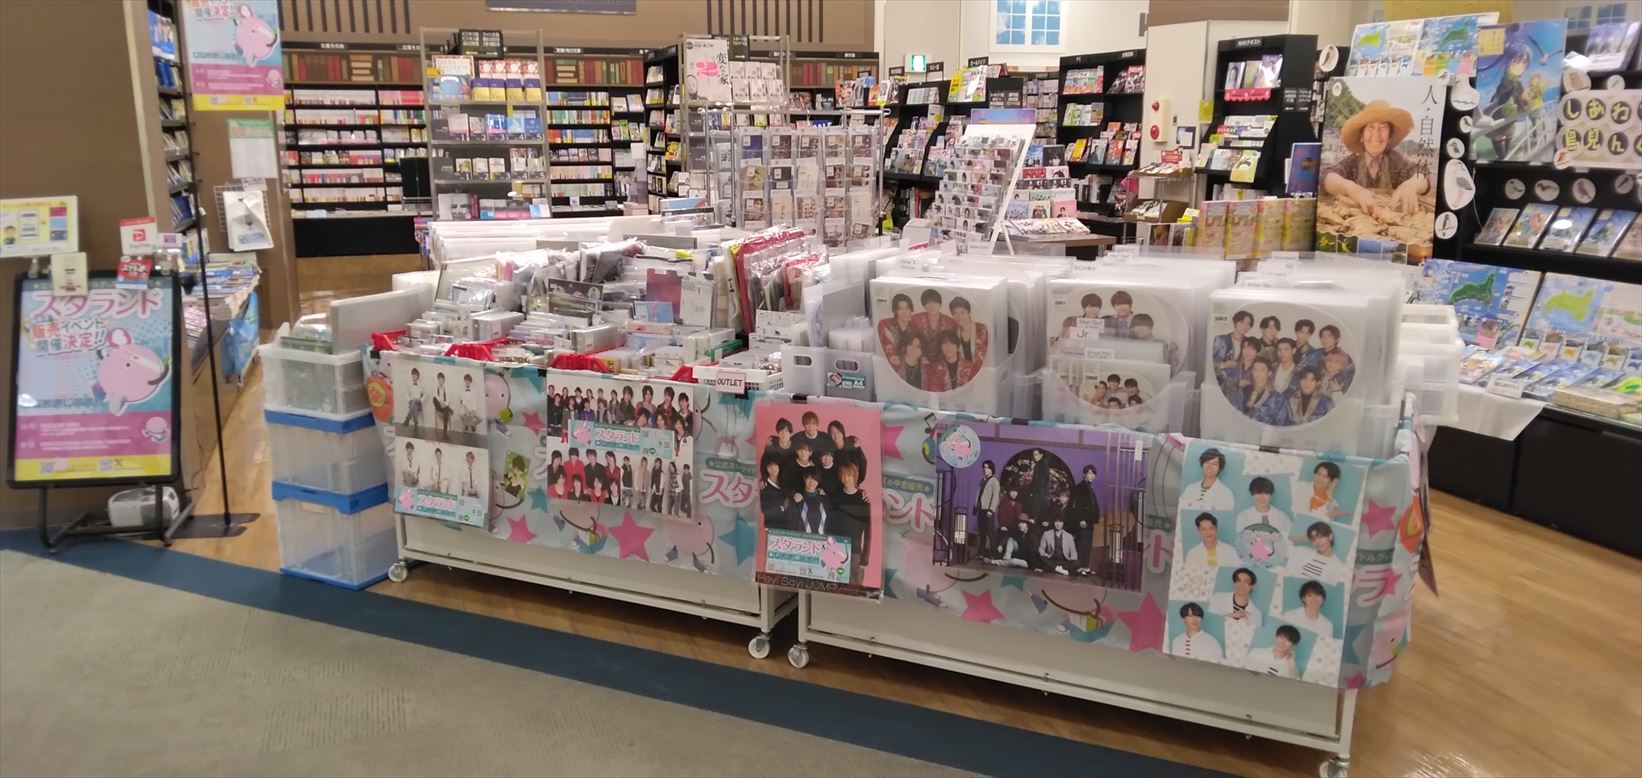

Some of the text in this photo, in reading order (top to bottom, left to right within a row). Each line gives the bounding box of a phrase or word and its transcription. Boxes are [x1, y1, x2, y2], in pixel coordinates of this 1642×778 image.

[1416, 85, 1437, 179] 人・自然体
[35, 290, 160, 317] スタランド
[1077, 330, 1089, 338] Jr
[717, 379, 743, 387] OUTLET
[768, 537, 820, 554] スタランド
[805, 578, 838, 591] JUMP
